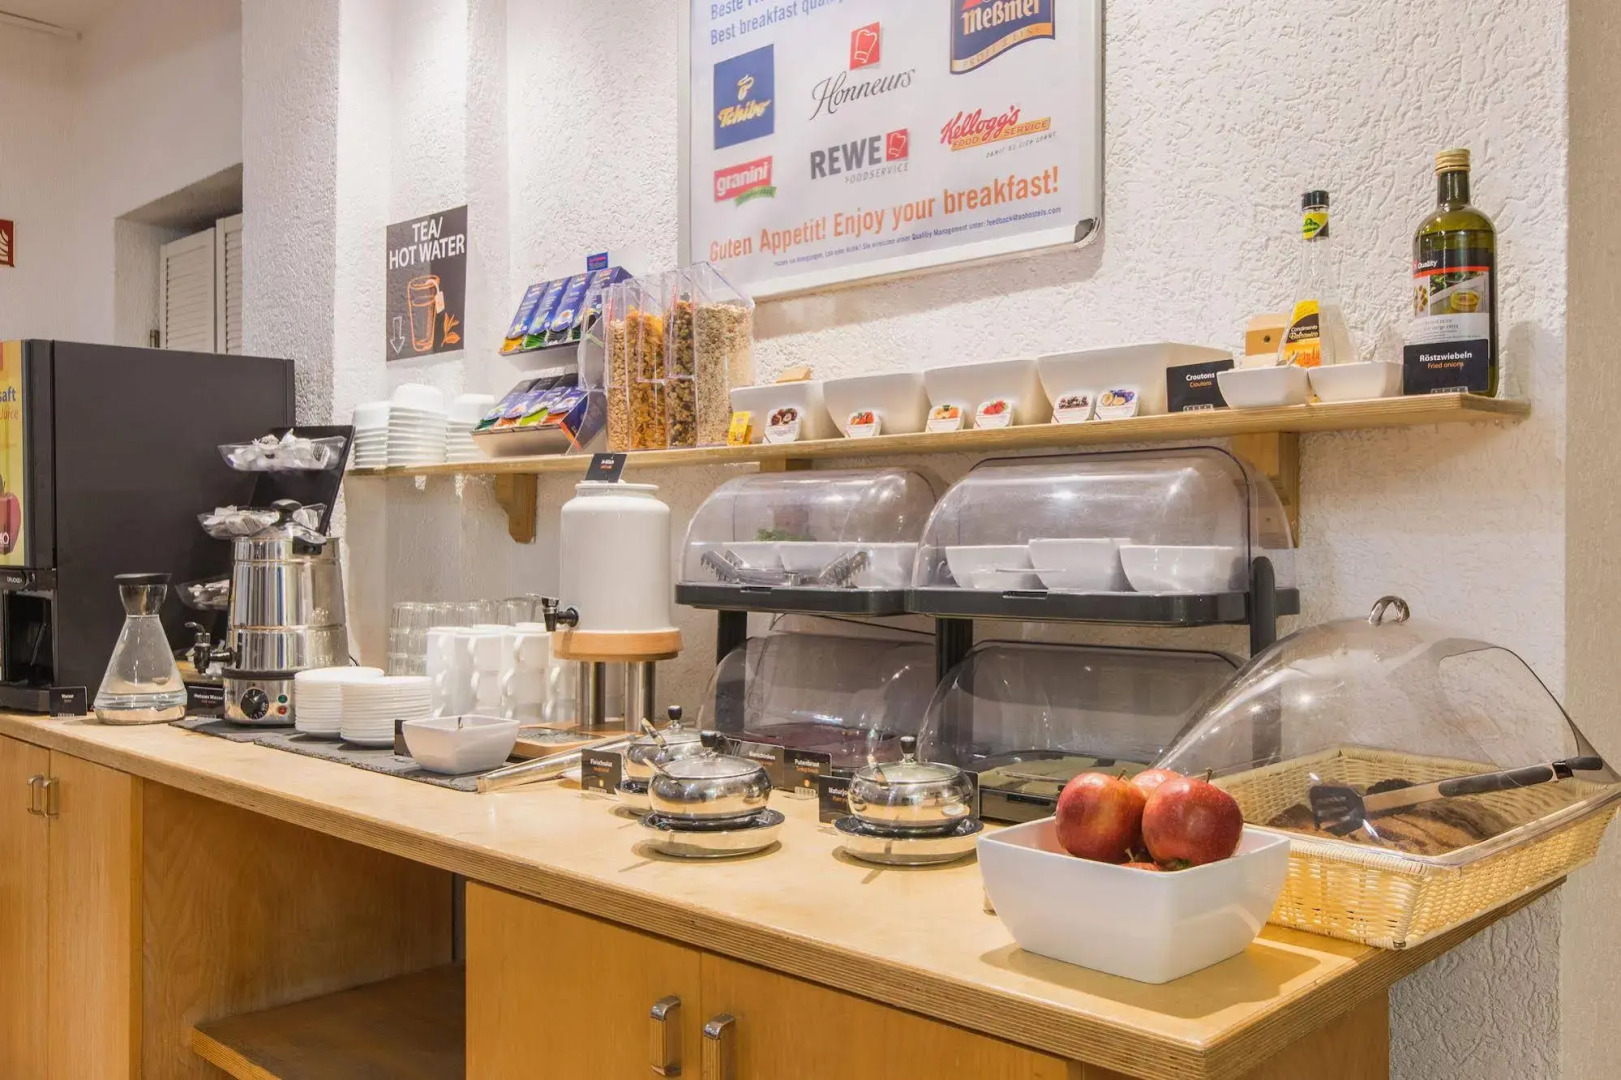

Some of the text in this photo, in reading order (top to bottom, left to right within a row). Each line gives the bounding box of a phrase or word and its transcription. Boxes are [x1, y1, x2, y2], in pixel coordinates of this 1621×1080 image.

[710, 0, 743, 20] Beste
[710, 23, 736, 45] Best
[739, 2, 797, 35] breakfast
[809, 69, 916, 121] Honneurs
[718, 99, 771, 128] Tchibo
[940, 104, 1021, 145] Kellogg's
[952, 119, 1049, 148] FOOD SERVICE
[810, 135, 882, 180] REWE
[716, 161, 770, 197] granini
[844, 162, 909, 184] FOODSERVICE
[709, 166, 1059, 262] Guten Appetit! Enjoy your breakfast!
[412, 216, 443, 243] TEA/
[933, 223, 968, 236] Management
[389, 233, 465, 270] HOT WATER
[1417, 260, 1438, 270] Quality
[1419, 351, 1473, 362] Röstzwiebeln
[1427, 362, 1443, 370] Fried
[1186, 373, 1215, 381] Croutons
